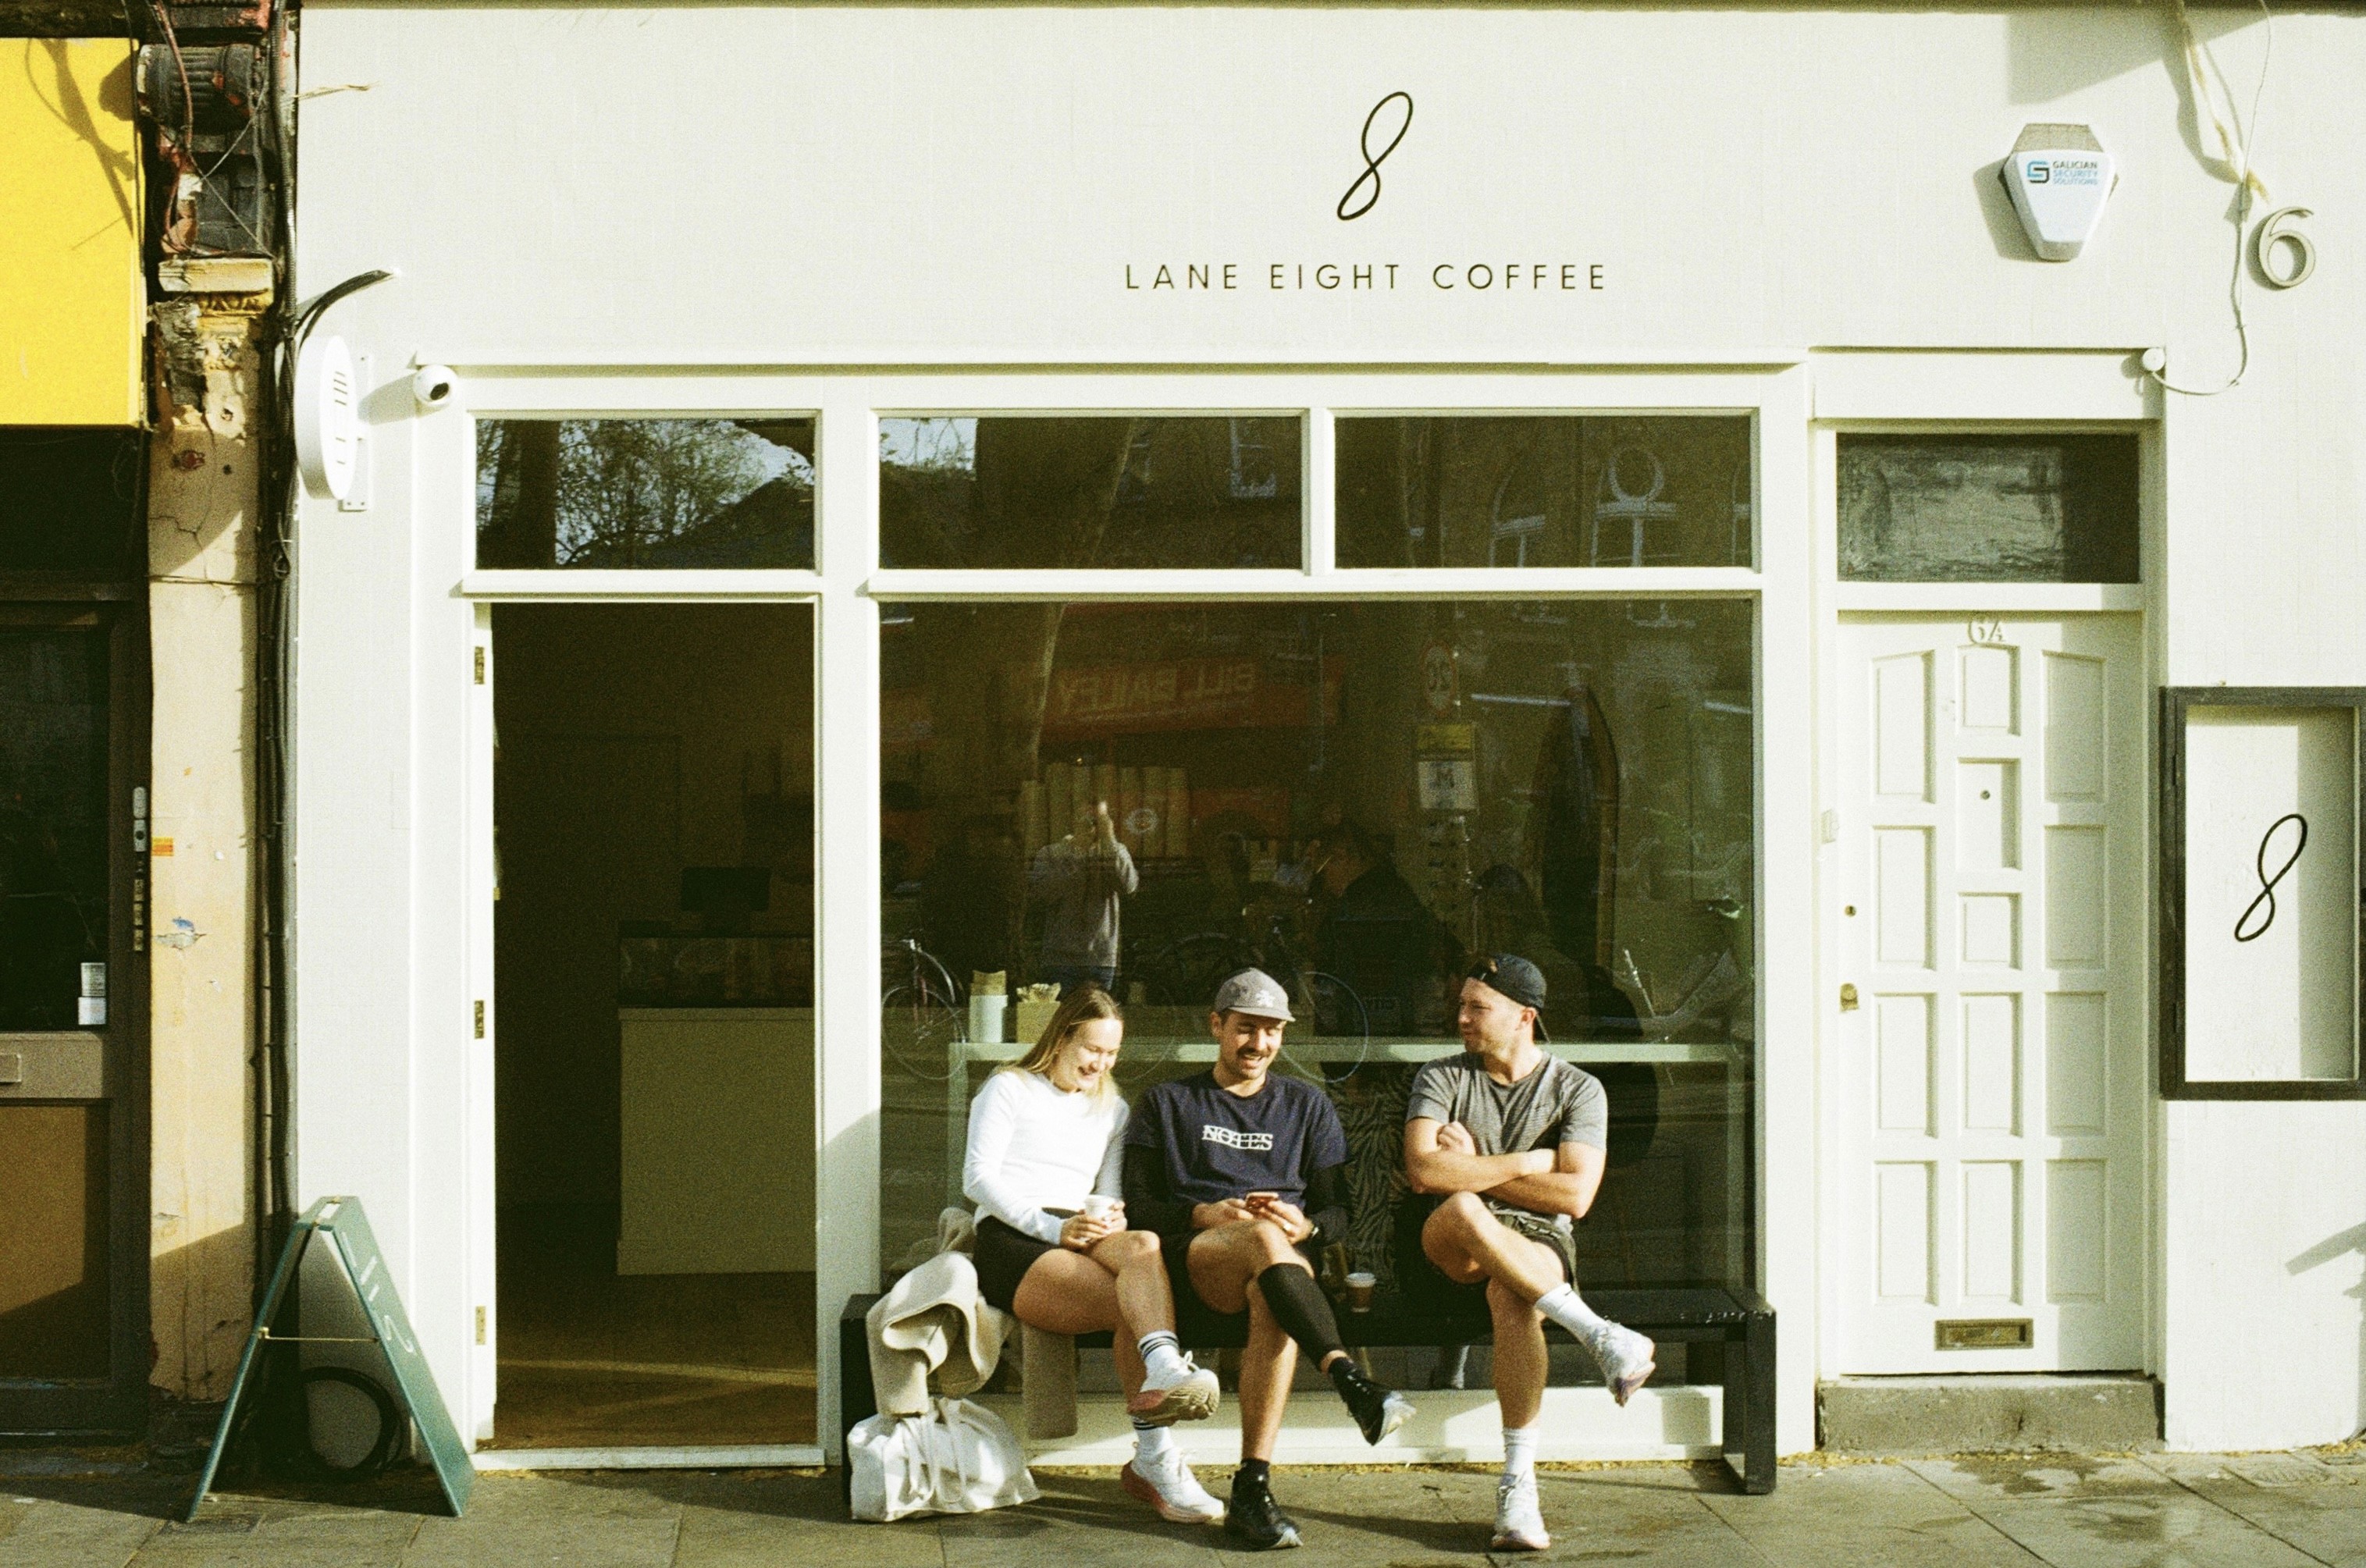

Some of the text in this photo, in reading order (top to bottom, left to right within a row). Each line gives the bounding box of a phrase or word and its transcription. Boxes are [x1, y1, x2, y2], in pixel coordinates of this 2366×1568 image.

[1337, 91, 1414, 221] 8
[2052, 161, 2098, 169] GALICIAN
[2257, 206, 2315, 289] 6
[1126, 264, 1604, 290] LANE EIGHT COFFEE
[2234, 813, 2308, 942] 8
[1201, 1125, 1273, 1150] NOTES
